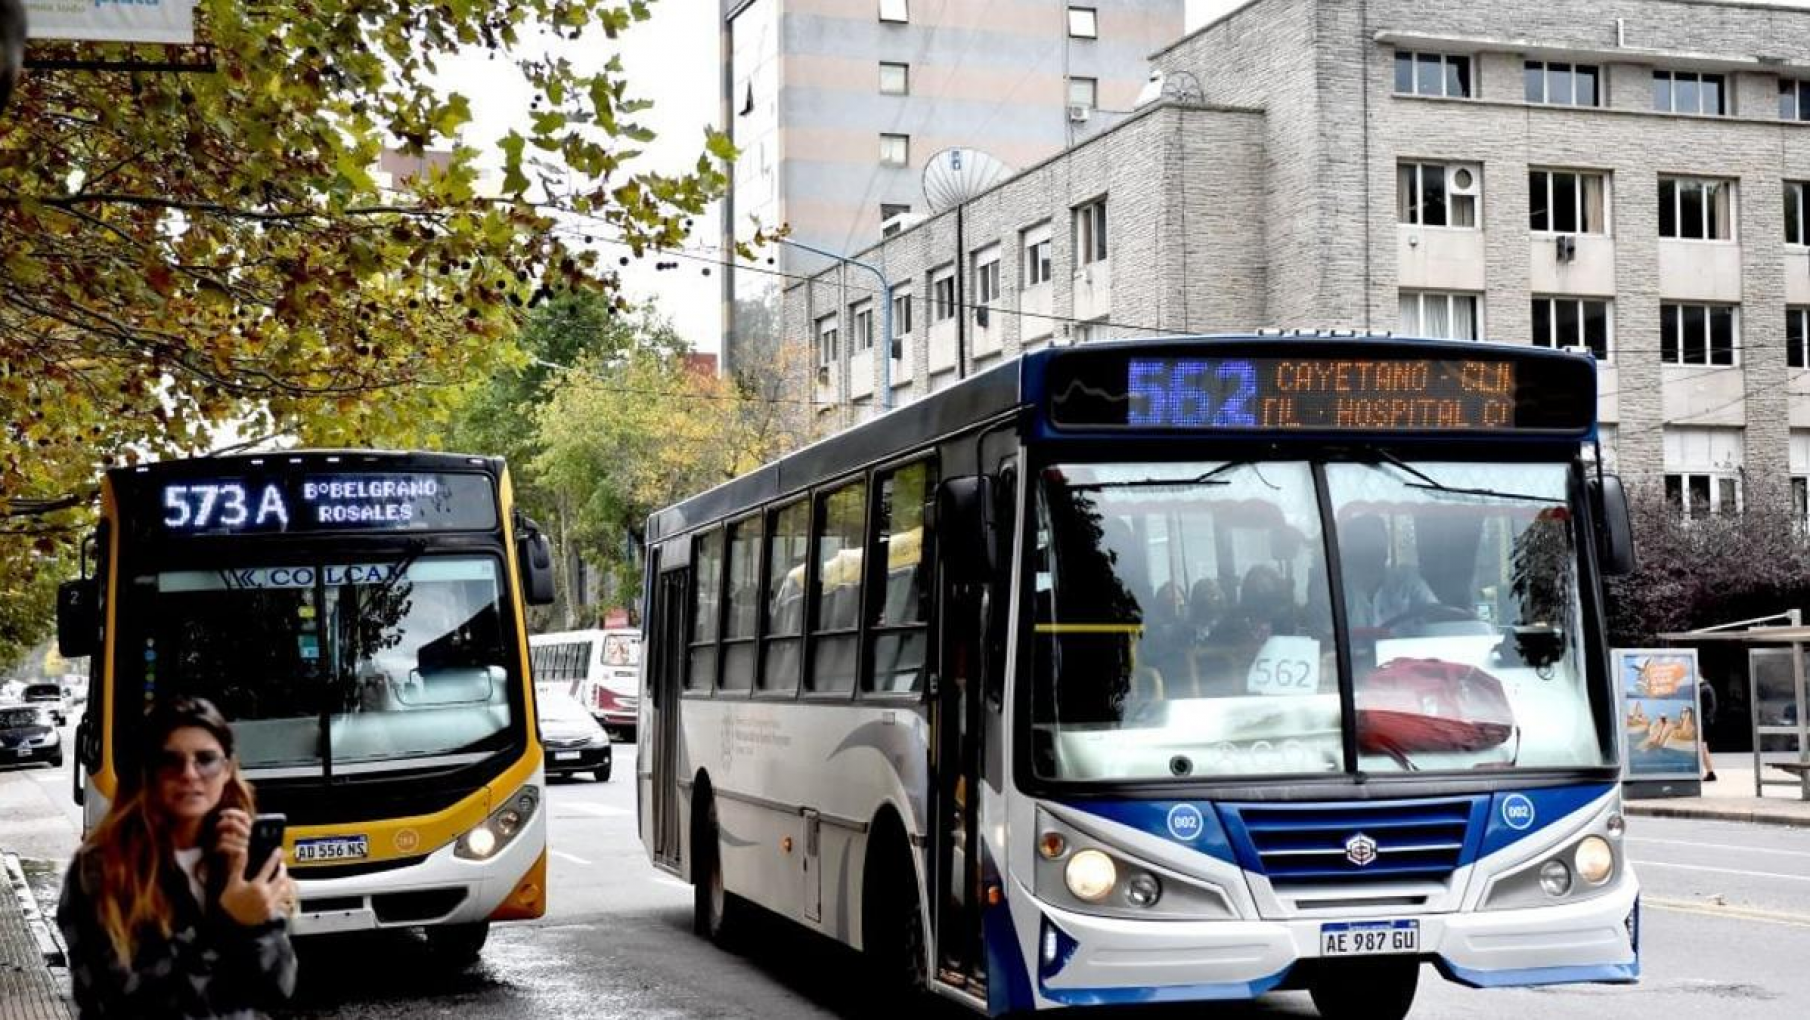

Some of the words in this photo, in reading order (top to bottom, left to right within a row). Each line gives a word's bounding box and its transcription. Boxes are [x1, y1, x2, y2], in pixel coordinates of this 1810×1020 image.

[1277, 361, 1428, 391] CAYETANO
[1128, 362, 1256, 427] 562
[1337, 398, 1470, 428] HOSPITAL
[164, 485, 249, 527] 573
[256, 484, 289, 525] A
[319, 503, 413, 523] ROSALES
[70, 590, 79, 605] 2
[1255, 658, 1312, 688] 562
[318, 844, 344, 857] 556
[1327, 933, 1348, 953] AE
[1354, 931, 1386, 952] 987
[1392, 930, 1415, 950] GU
